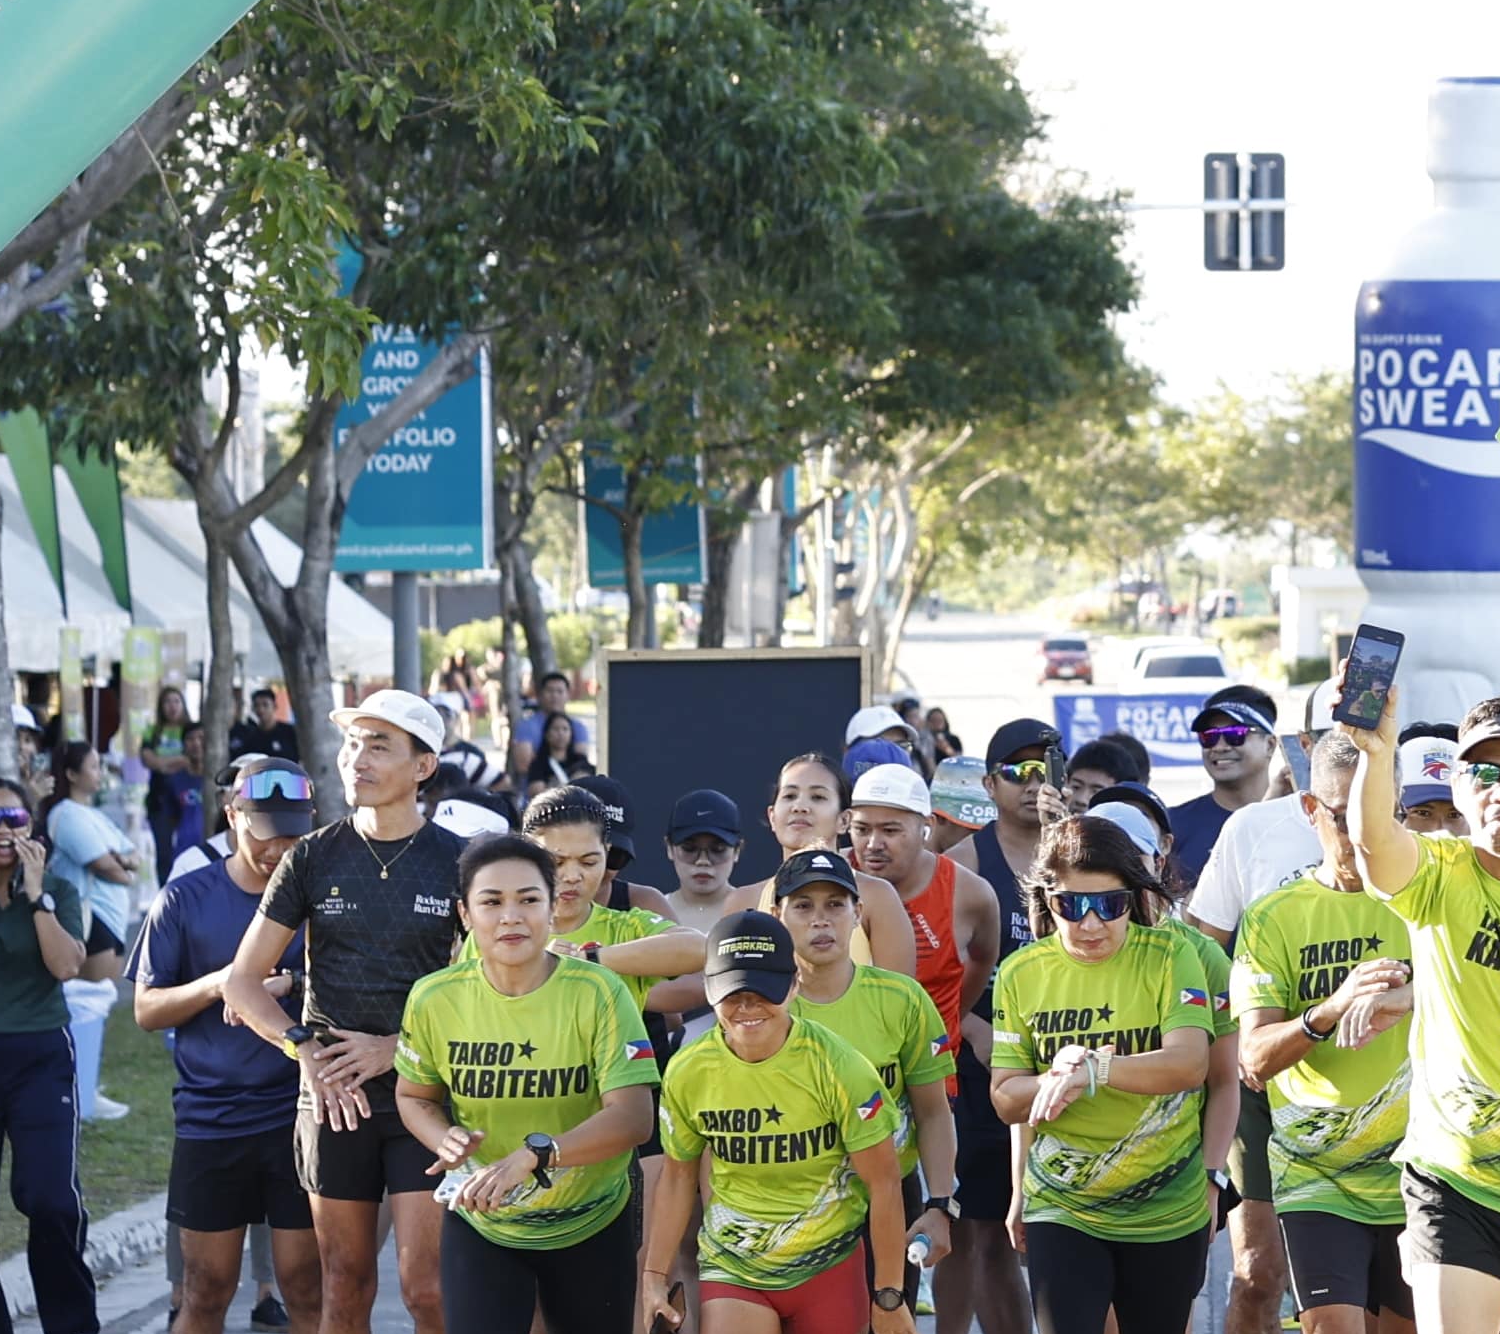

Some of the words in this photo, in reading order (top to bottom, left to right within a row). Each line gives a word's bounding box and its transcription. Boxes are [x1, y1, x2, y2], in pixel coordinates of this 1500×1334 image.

[373, 351, 419, 369] AND
[362, 377, 415, 395] GRO
[366, 454, 432, 472] TODAY
[413, 903, 431, 914] Run
[431, 906, 451, 917] Club
[414, 893, 451, 909] Rockwell
[1299, 937, 1364, 969] TAKBO
[1032, 1007, 1094, 1035] TAKBO
[447, 1040, 515, 1067] TAKBO
[450, 1063, 590, 1099] KABITENYO
[698, 1107, 763, 1134] TAKBO
